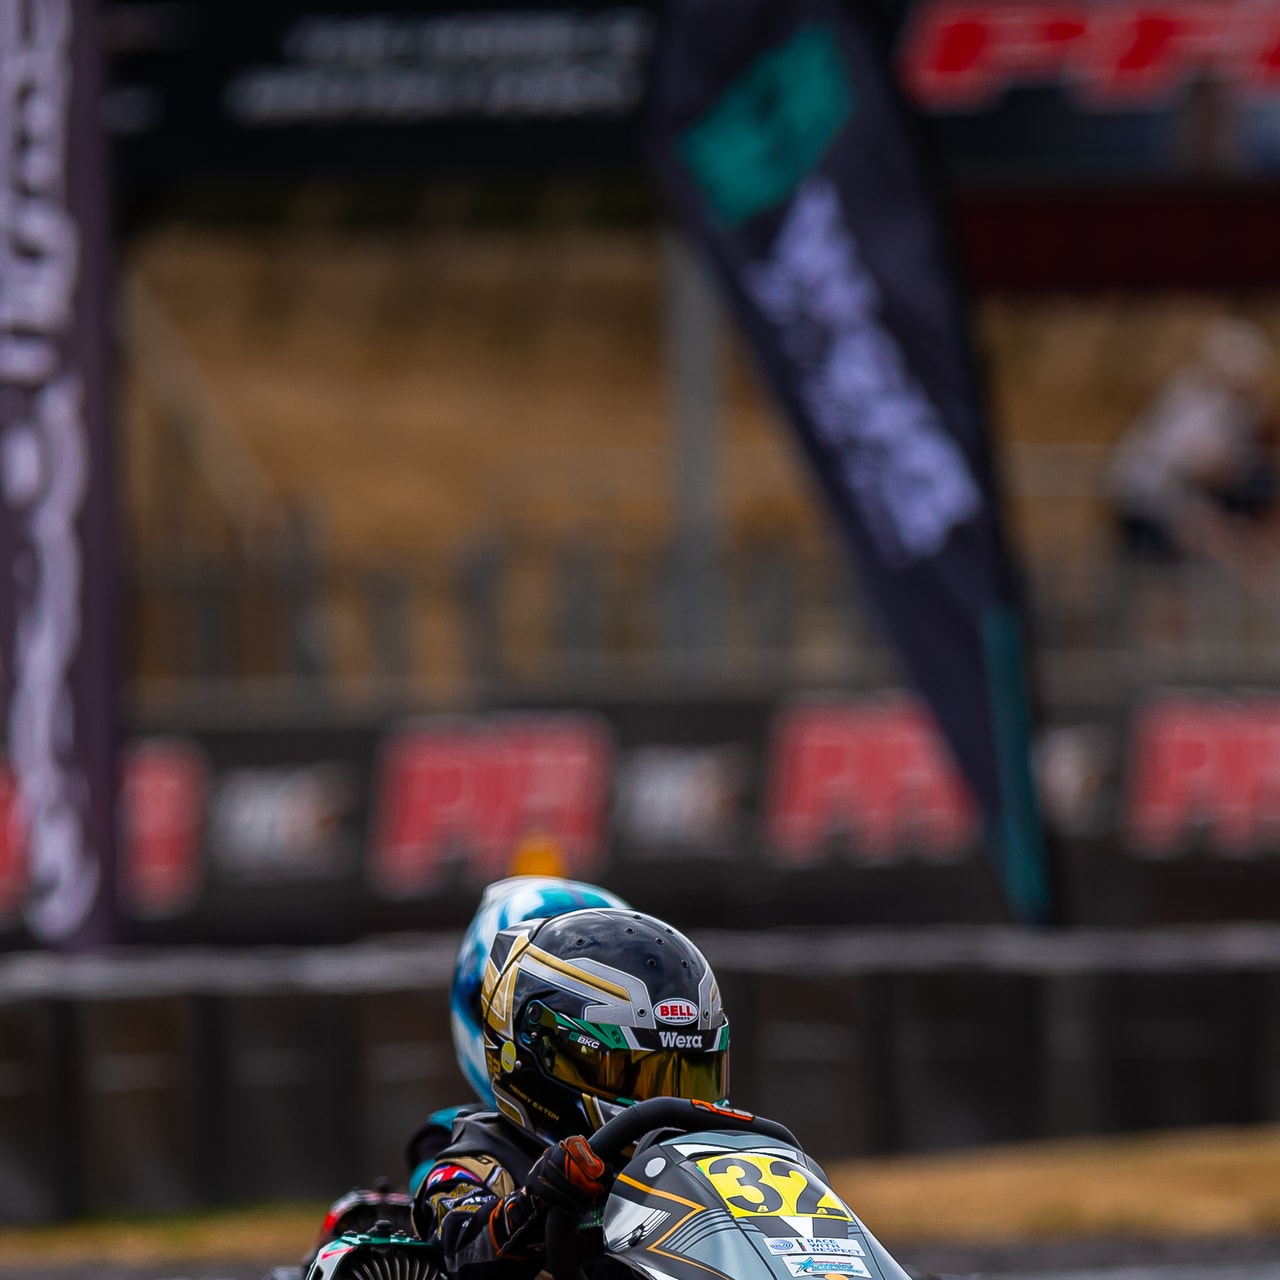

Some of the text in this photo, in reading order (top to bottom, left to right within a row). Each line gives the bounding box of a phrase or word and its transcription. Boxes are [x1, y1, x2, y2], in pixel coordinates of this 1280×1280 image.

[660, 1005, 695, 1017] BELL
[577, 1034, 600, 1049] BKC
[659, 1031, 703, 1049] Wera
[709, 1157, 850, 1218] 32
[812, 1247, 861, 1255] RESPECT
